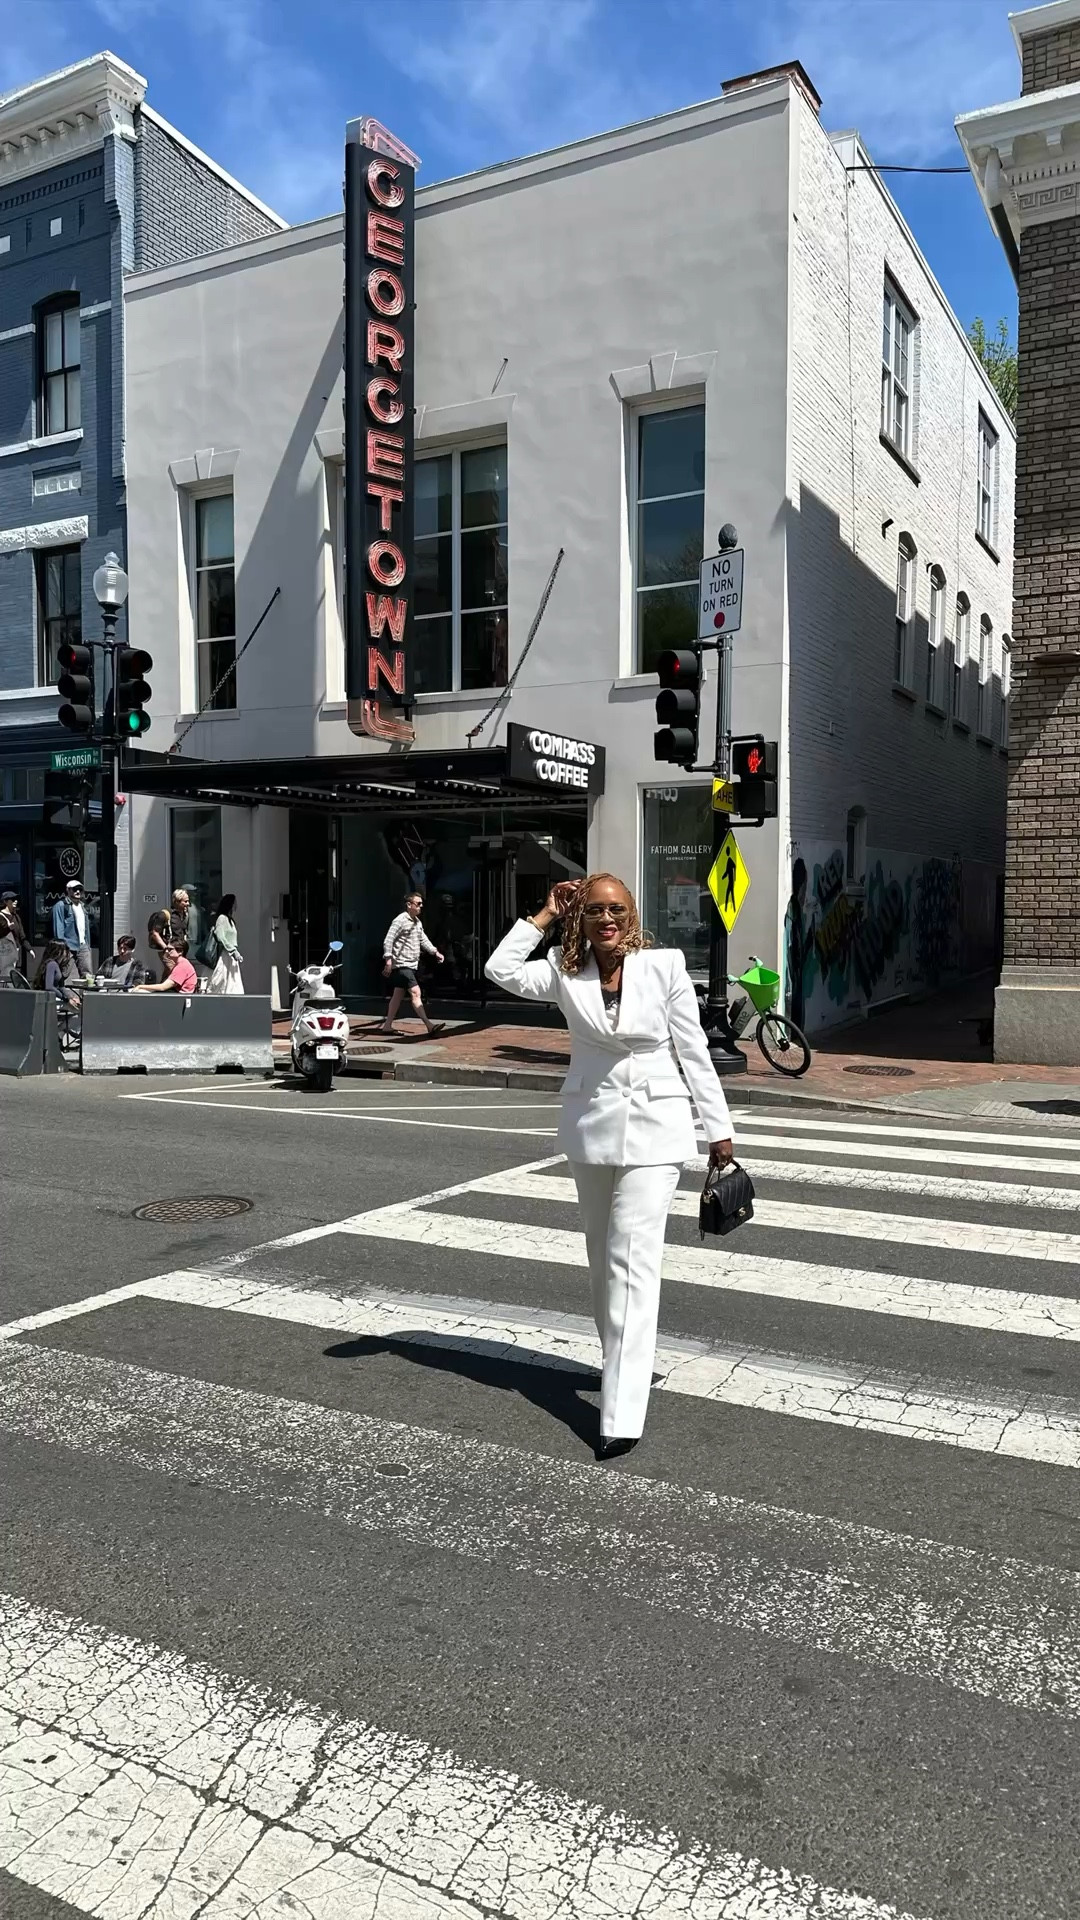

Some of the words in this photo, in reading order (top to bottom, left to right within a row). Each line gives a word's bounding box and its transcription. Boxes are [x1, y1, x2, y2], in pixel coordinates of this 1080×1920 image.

[365, 158, 406, 696] GEORGETOWN
[712, 559, 731, 577] NO
[709, 577, 734, 595] TURN
[703, 598, 716, 613] ON
[720, 593, 738, 609] RED
[528, 730, 596, 766] COMPASS
[54, 751, 92, 767] Wisconsin
[535, 758, 589, 789] COFFEE
[716, 788, 733, 804] AHE
[651, 845, 679, 854] FATHOM
[681, 844, 713, 854] GALLERY
